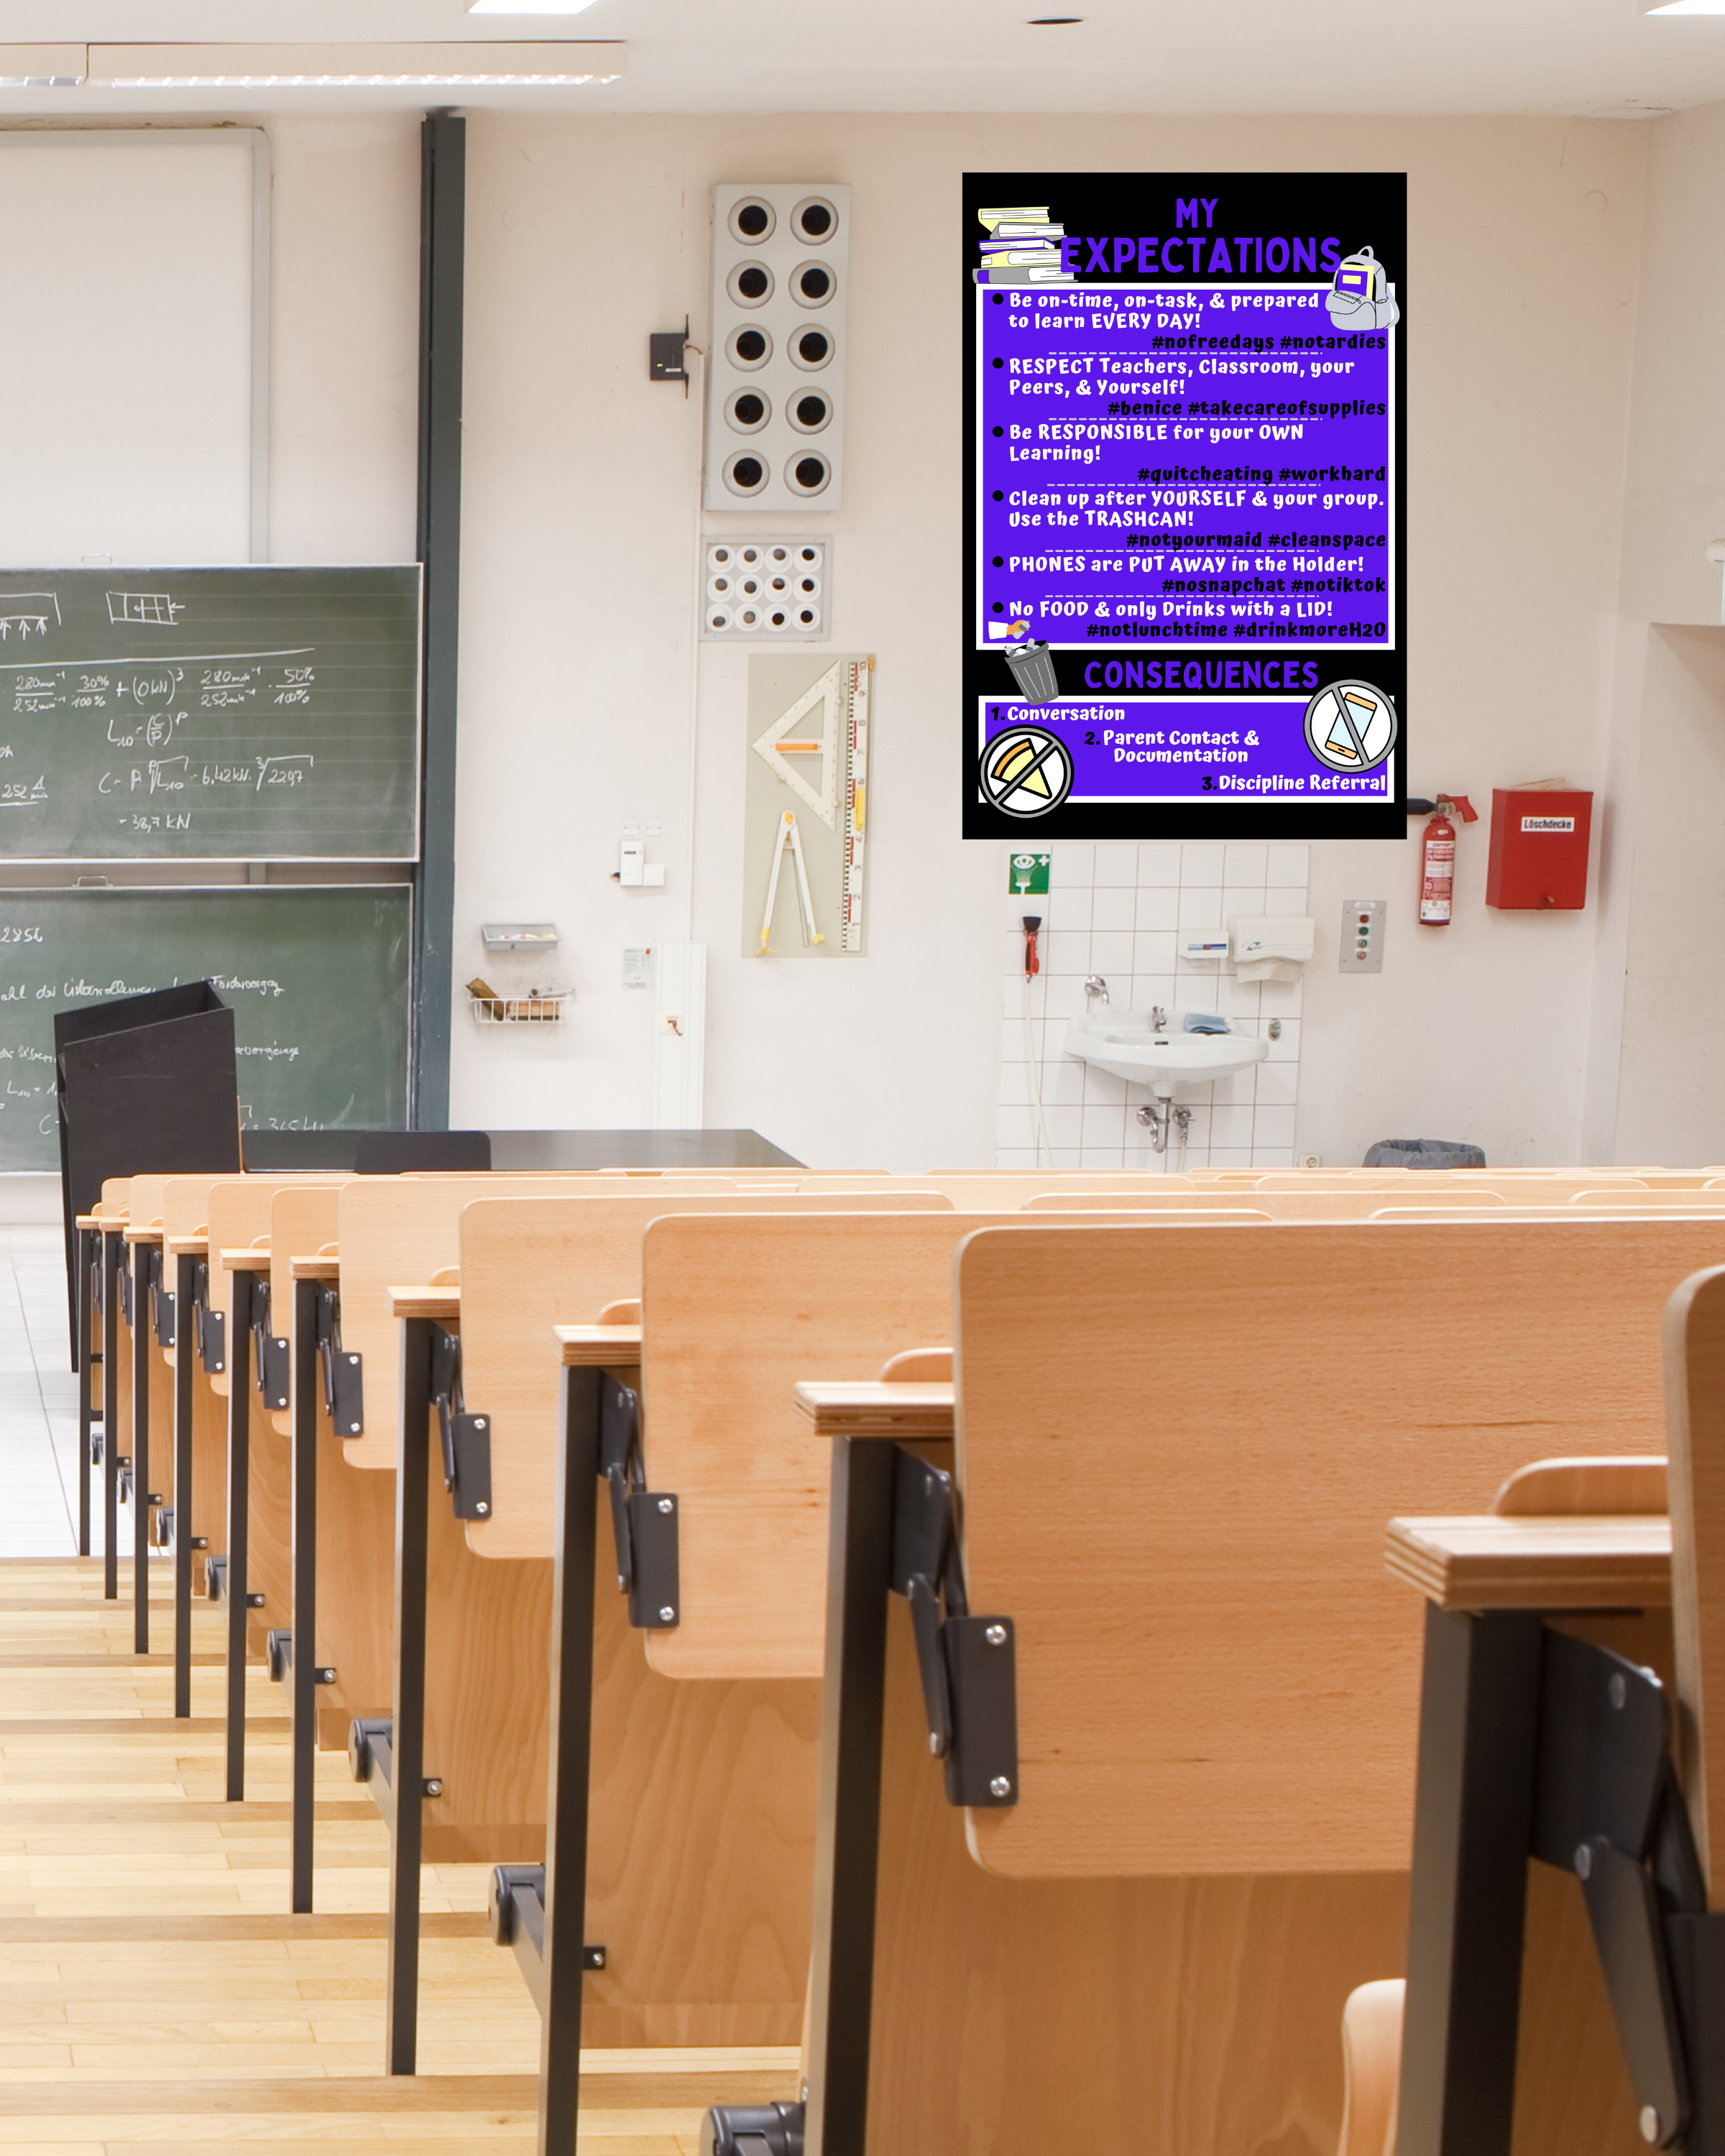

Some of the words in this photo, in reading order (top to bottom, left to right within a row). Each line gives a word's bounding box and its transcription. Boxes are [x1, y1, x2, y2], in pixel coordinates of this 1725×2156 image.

[1177, 198, 1218, 228] MY
[1060, 237, 1342, 273] EXPECTATIONS
[1011, 292, 1031, 307] Be
[1038, 292, 1118, 311] on-time,
[1125, 292, 1203, 311] on-task,
[1210, 293, 1225, 308] &
[1232, 293, 1318, 311] prepared
[1008, 315, 1029, 328] to
[1035, 313, 1085, 328] learn
[1092, 313, 1151, 329] EVERY
[1158, 313, 1200, 329] DAY!
[1152, 334, 1274, 352] #nofreedays
[1280, 333, 1386, 349] #notardies
[1010, 358, 1093, 374] RESPECT
[1100, 358, 1192, 377] Teachers,
[1199, 359, 1305, 377] Classroom,
[1311, 362, 1354, 377] your
[1010, 379, 1070, 398] Peers,
[1076, 379, 1091, 395] &
[1097, 379, 1184, 395] Yourself!
[1108, 400, 1182, 415] #benice
[1188, 400, 1386, 418] #takecareofsupplies
[1011, 425, 1031, 439] Be
[1039, 424, 1167, 441] RESPONSIBLE
[1173, 425, 1204, 439] for
[1210, 428, 1254, 443] your
[1259, 424, 1302, 441] OWN
[1010, 445, 1100, 464] Learning!
[1138, 466, 1272, 484] #quitcheating
[1279, 466, 1385, 481] #workhard
[1009, 491, 1061, 506] Clean
[1067, 494, 1089, 509] up
[1095, 491, 1146, 505] after
[1151, 490, 1246, 507] YOURSELF
[1252, 491, 1267, 506] &
[1274, 494, 1317, 510] your
[1323, 494, 1384, 510] group.
[1009, 512, 1041, 527] Use
[1047, 511, 1078, 526] the
[1085, 510, 1193, 528] TRASHCAN!
[1127, 532, 1261, 550] #notyourmaid
[1269, 532, 1385, 550] #cleanspace
[1010, 556, 1085, 572] PHONES
[1091, 560, 1122, 571] are
[1130, 556, 1164, 572] PUT
[1170, 557, 1225, 573] AWAY
[1232, 556, 1248, 571] in
[1255, 556, 1286, 571] the
[1293, 556, 1363, 572] Holder!
[1162, 577, 1285, 596] #nosnapchat
[1292, 577, 1385, 592] #notiktok
[1010, 601, 1033, 616] No
[1040, 601, 1088, 617] FOOD
[1095, 602, 1110, 617] &
[1116, 602, 1156, 619] only
[1163, 601, 1225, 617] Drinks
[1231, 601, 1274, 616] with
[1280, 604, 1289, 616] a
[1297, 602, 1332, 617] LID!
[1087, 622, 1227, 637] #notlunchtime
[1085, 661, 1318, 689] CONSEQUENCES
[991, 706, 1005, 720] 1.
[1008, 706, 1125, 720] Conversation
[1085, 732, 1100, 745] 2.
[1104, 730, 1164, 745] Parent
[1169, 731, 1239, 745] Contact
[1244, 730, 1259, 745] &
[1115, 747, 1248, 763] Documentation
[1202, 777, 1217, 790] 3.
[1220, 775, 1305, 793] Discipline
[1310, 775, 1385, 791] Referral
[1524, 819, 1572, 829] Löschdecke
